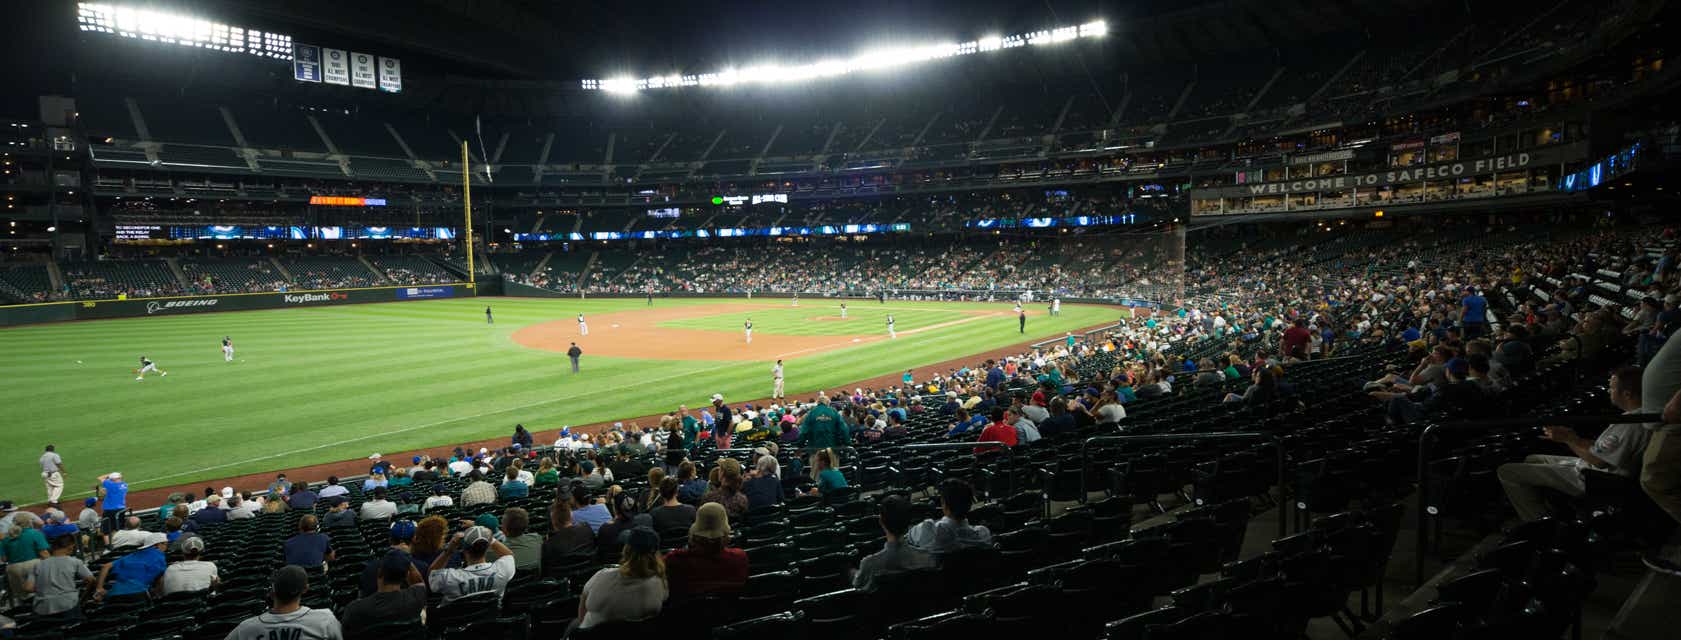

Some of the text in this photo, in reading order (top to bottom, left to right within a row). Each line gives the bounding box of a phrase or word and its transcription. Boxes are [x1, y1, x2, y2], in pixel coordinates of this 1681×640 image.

[1250, 153, 1530, 194] WELCOME TO SAFECO FIELD
[166, 299, 218, 308] BOEING
[284, 293, 331, 304] KeyBank
